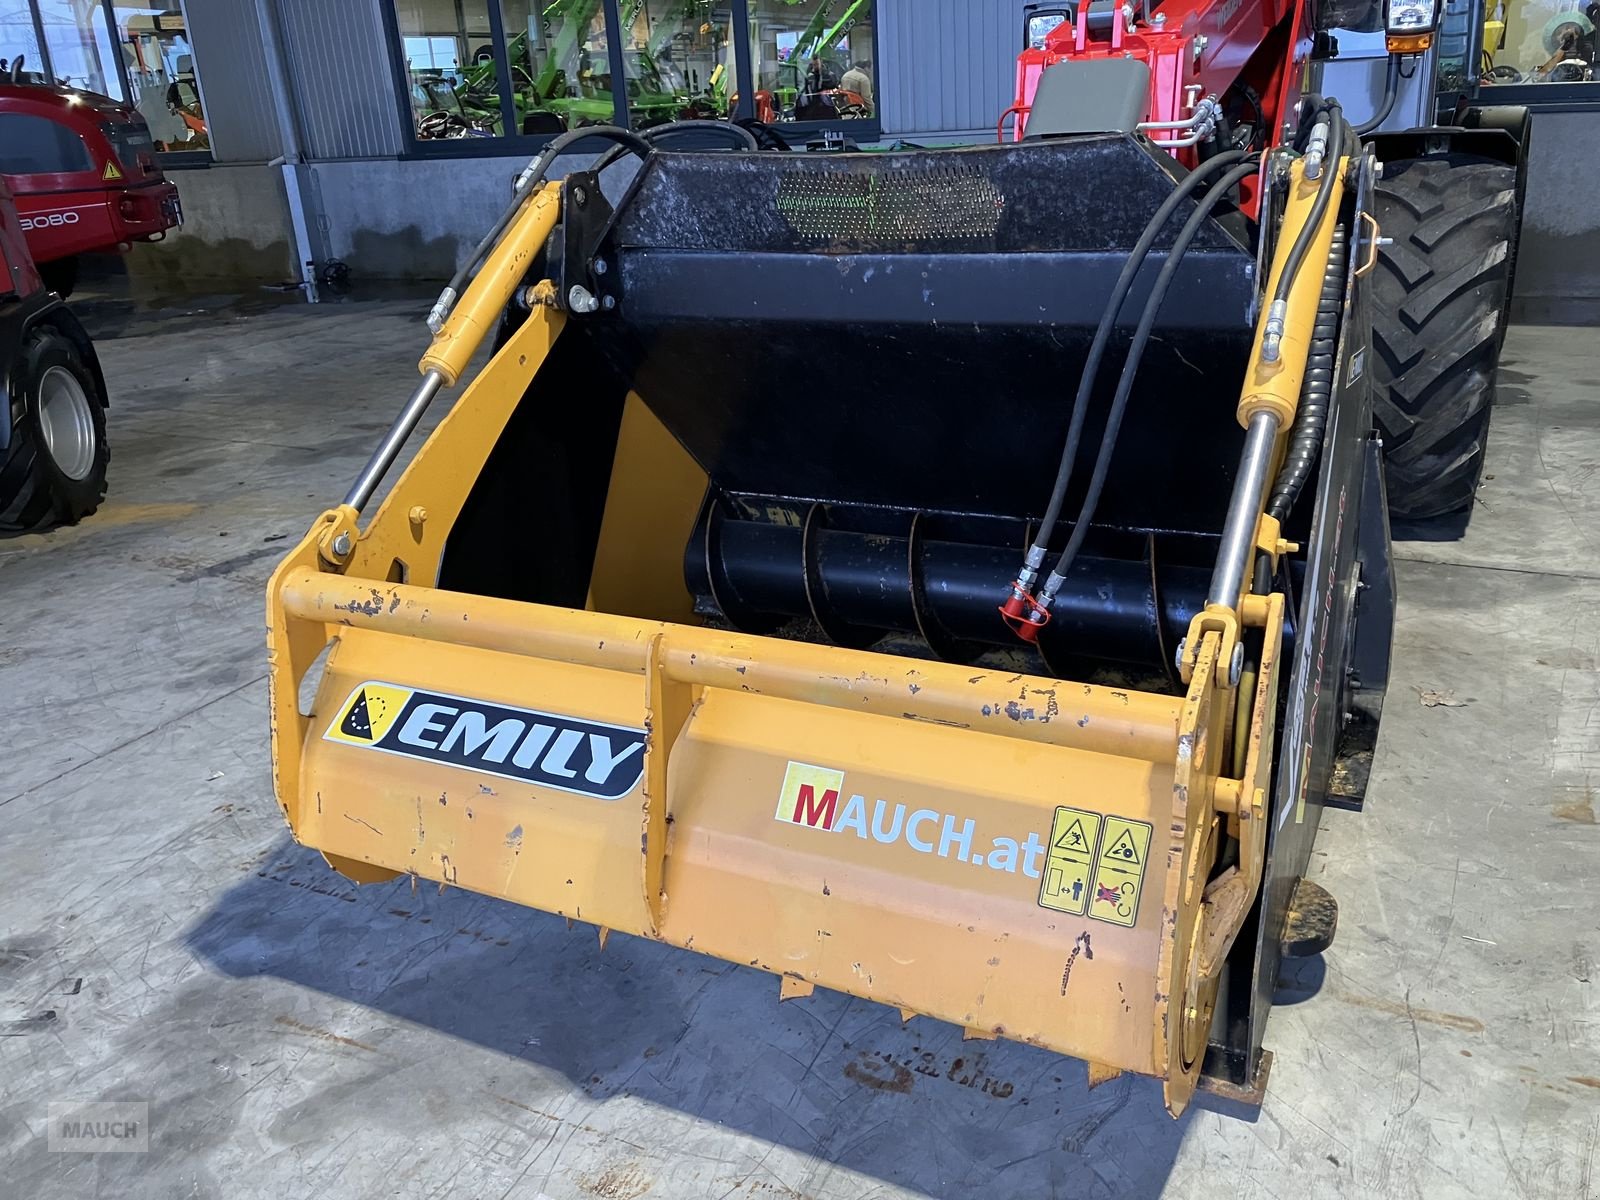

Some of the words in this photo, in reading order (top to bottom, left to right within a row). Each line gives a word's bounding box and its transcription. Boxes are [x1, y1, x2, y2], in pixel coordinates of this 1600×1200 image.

[20, 212, 79, 230] 3080
[398, 703, 645, 785] EMILY
[792, 783, 1044, 879] MAUCH.at
